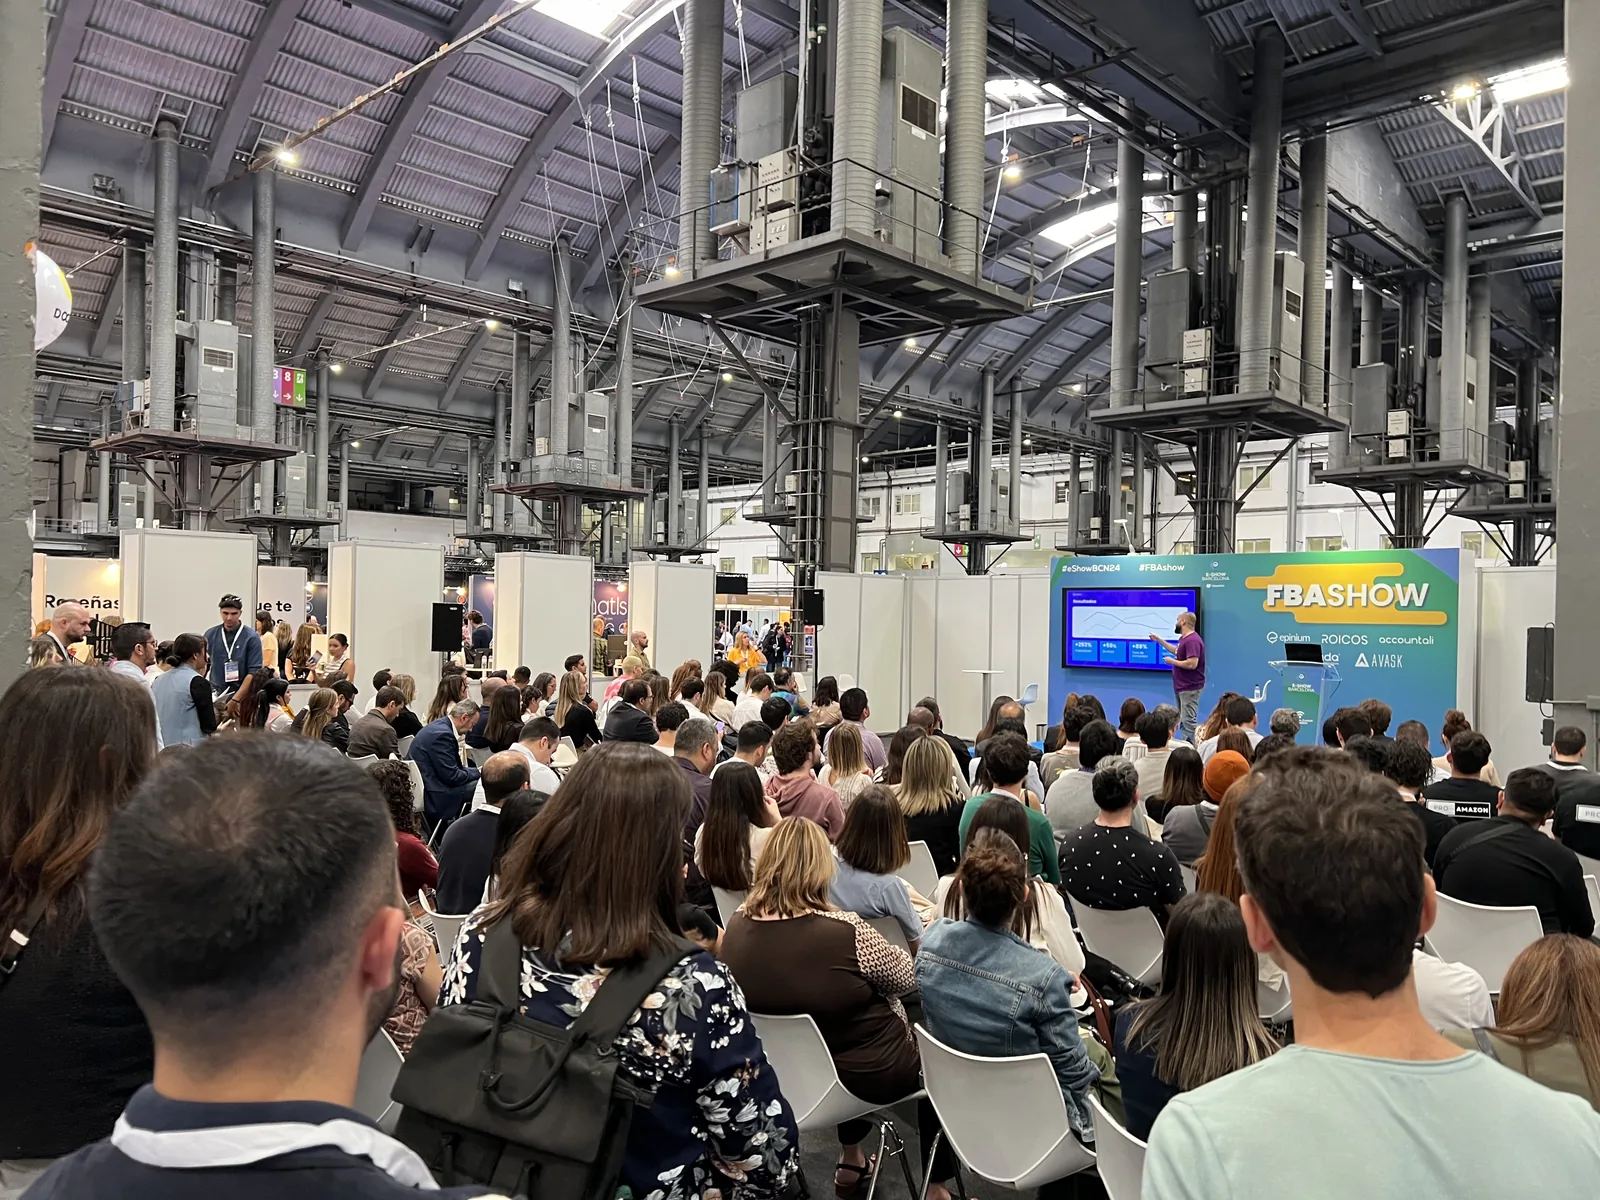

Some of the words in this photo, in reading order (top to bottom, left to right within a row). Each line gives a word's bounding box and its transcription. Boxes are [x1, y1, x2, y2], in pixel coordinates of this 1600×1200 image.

[284, 371, 291, 382] 8
[1062, 564, 1120, 572] #eShowBCN24
[1139, 563, 1185, 572] #FBAshow
[1267, 583, 1429, 607] FBASHOW
[276, 600, 292, 612] te
[1279, 632, 1311, 643] epinium
[1321, 634, 1368, 645] ROICOS
[1378, 635, 1434, 645] accountali
[1371, 654, 1403, 668] AVASK
[1456, 806, 1489, 814] AMAZON
